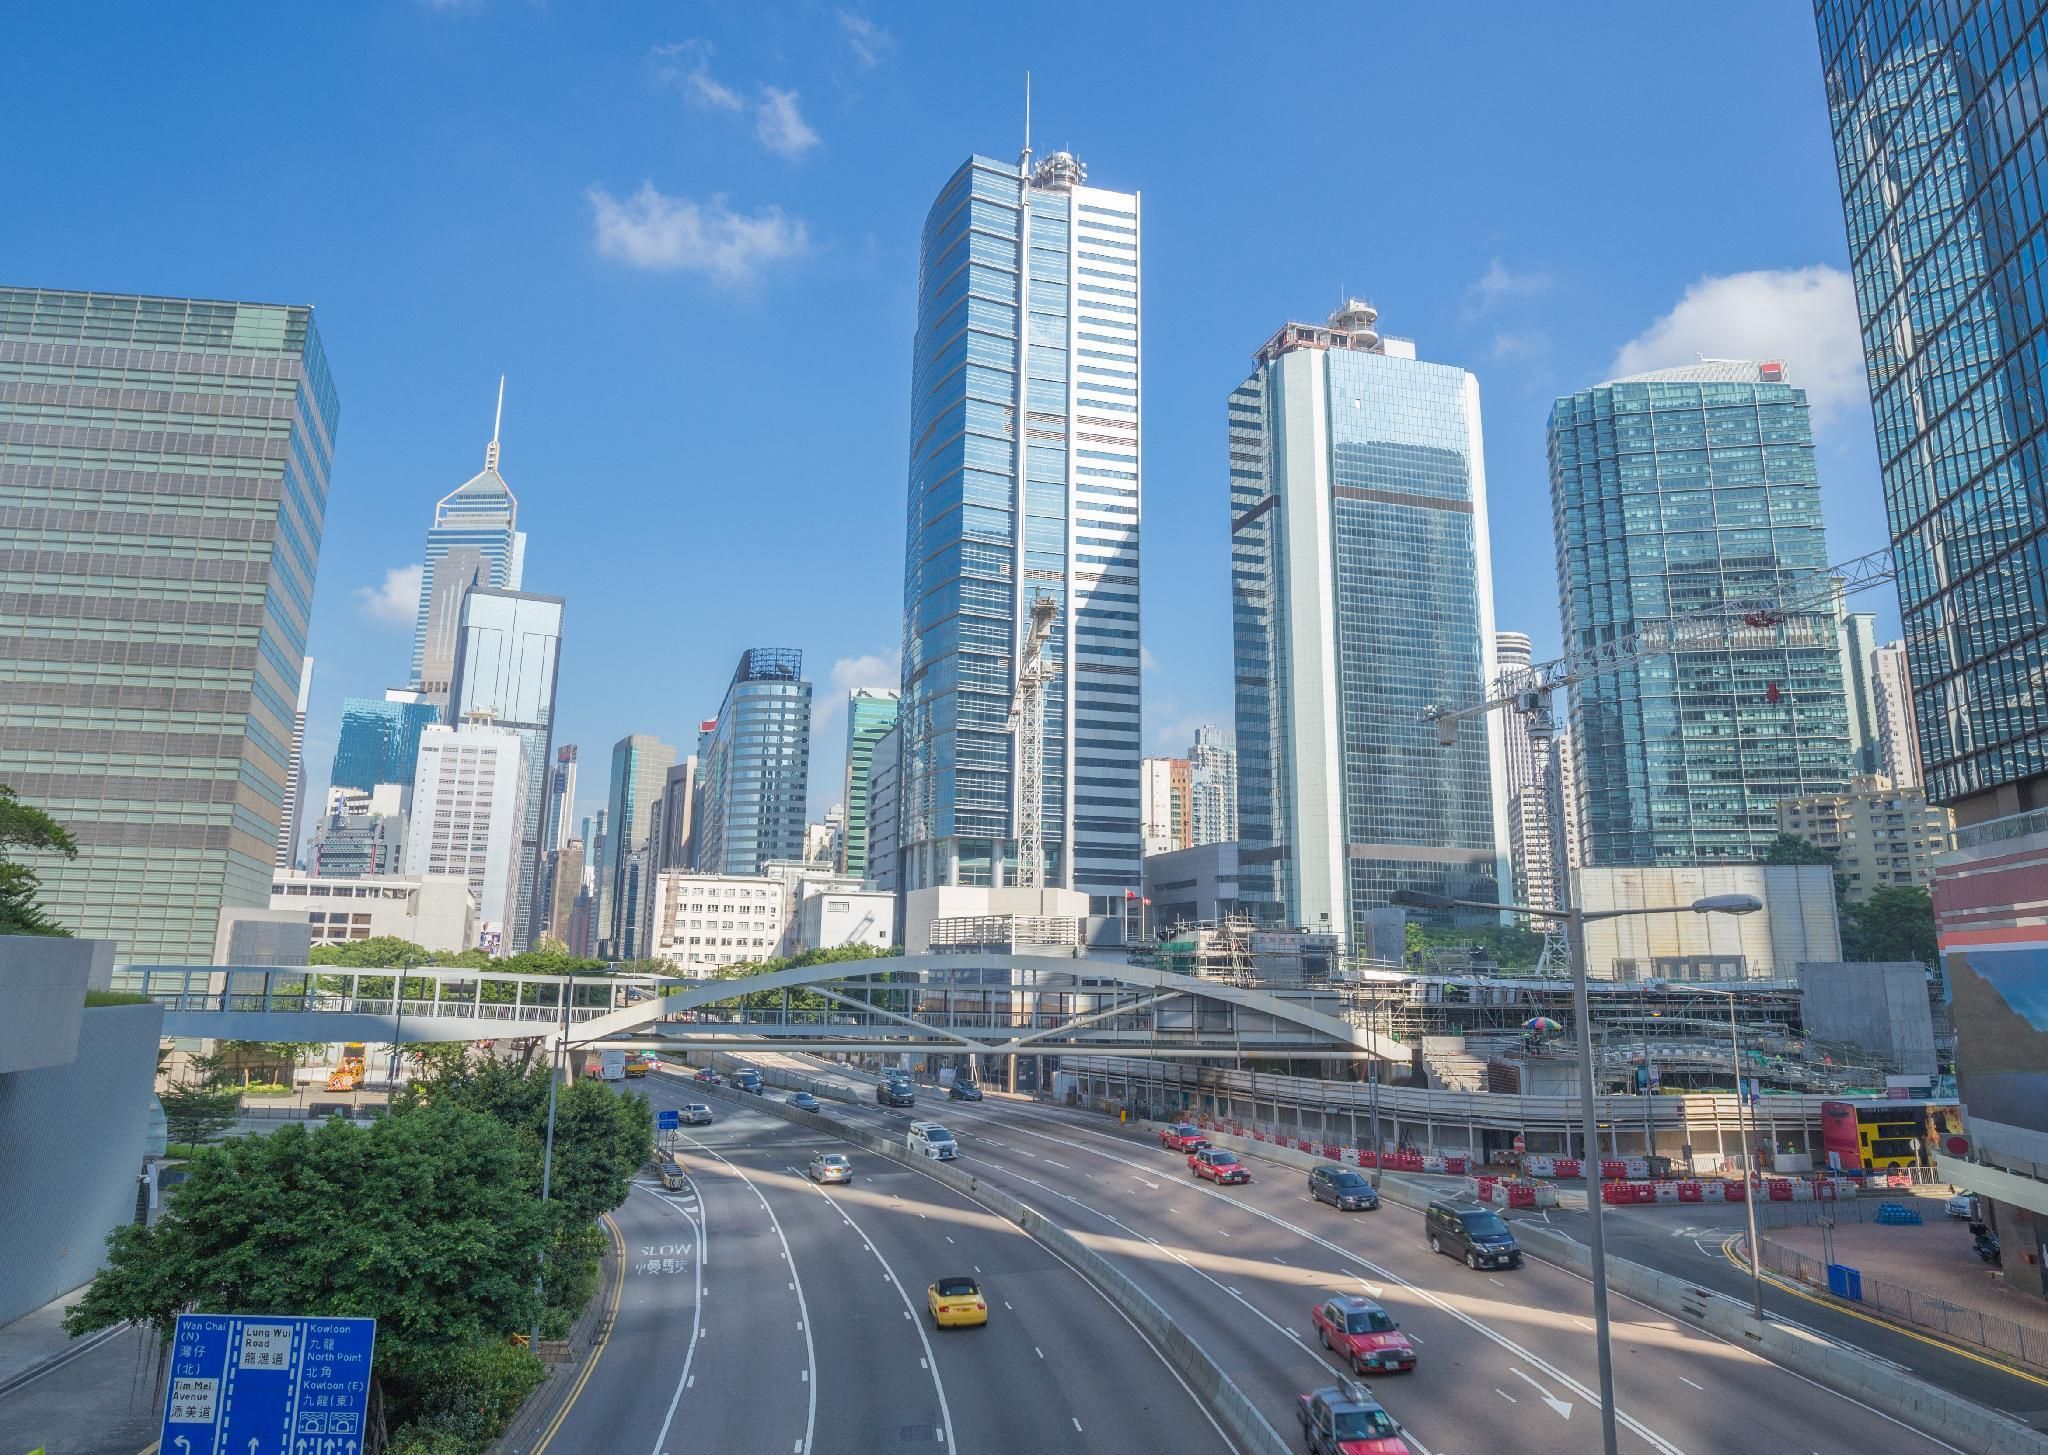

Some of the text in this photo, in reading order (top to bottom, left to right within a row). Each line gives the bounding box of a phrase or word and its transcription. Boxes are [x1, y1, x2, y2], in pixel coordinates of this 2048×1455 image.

[640, 1244, 691, 1256] SLOW
[635, 1258, 688, 1275] 慢駛
[182, 1321, 227, 1331] Wan Chai
[310, 1324, 351, 1334] Kowloon
[181, 1332, 200, 1342] (N)
[246, 1328, 291, 1338] Lung Wui
[245, 1338, 270, 1348] Road
[309, 1338, 335, 1351] 九龍
[179, 1344, 206, 1358] 灣仔
[307, 1352, 362, 1362] North Point
[177, 1361, 200, 1375] (北)
[306, 1365, 332, 1378] 北角
[174, 1381, 212, 1390] Tim Mei
[303, 1380, 364, 1393] Kowloon (E)
[173, 1391, 208, 1401] Avenue
[303, 1394, 354, 1407] 九龍(東)
[170, 1405, 211, 1419] 添美道
